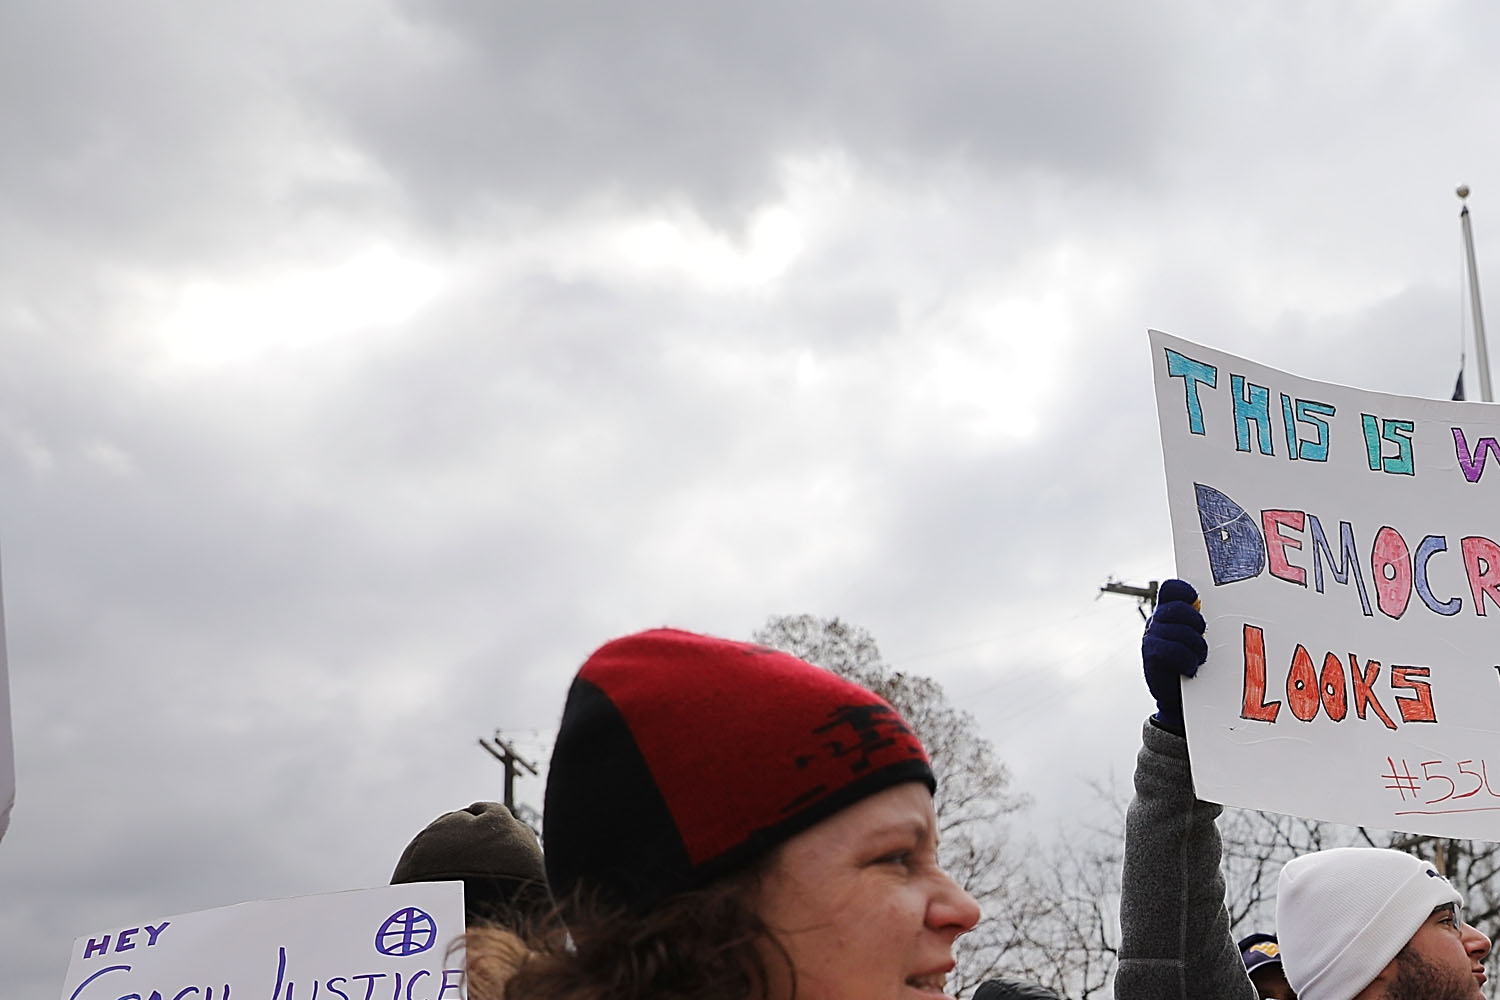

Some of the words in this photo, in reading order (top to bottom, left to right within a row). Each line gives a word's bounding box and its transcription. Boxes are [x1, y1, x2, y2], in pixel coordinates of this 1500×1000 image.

[1165, 347, 1336, 463] THIS
[1361, 412, 1415, 476] IS
[1240, 623, 1438, 731] LOOKS
[83, 921, 171, 959] HEY
